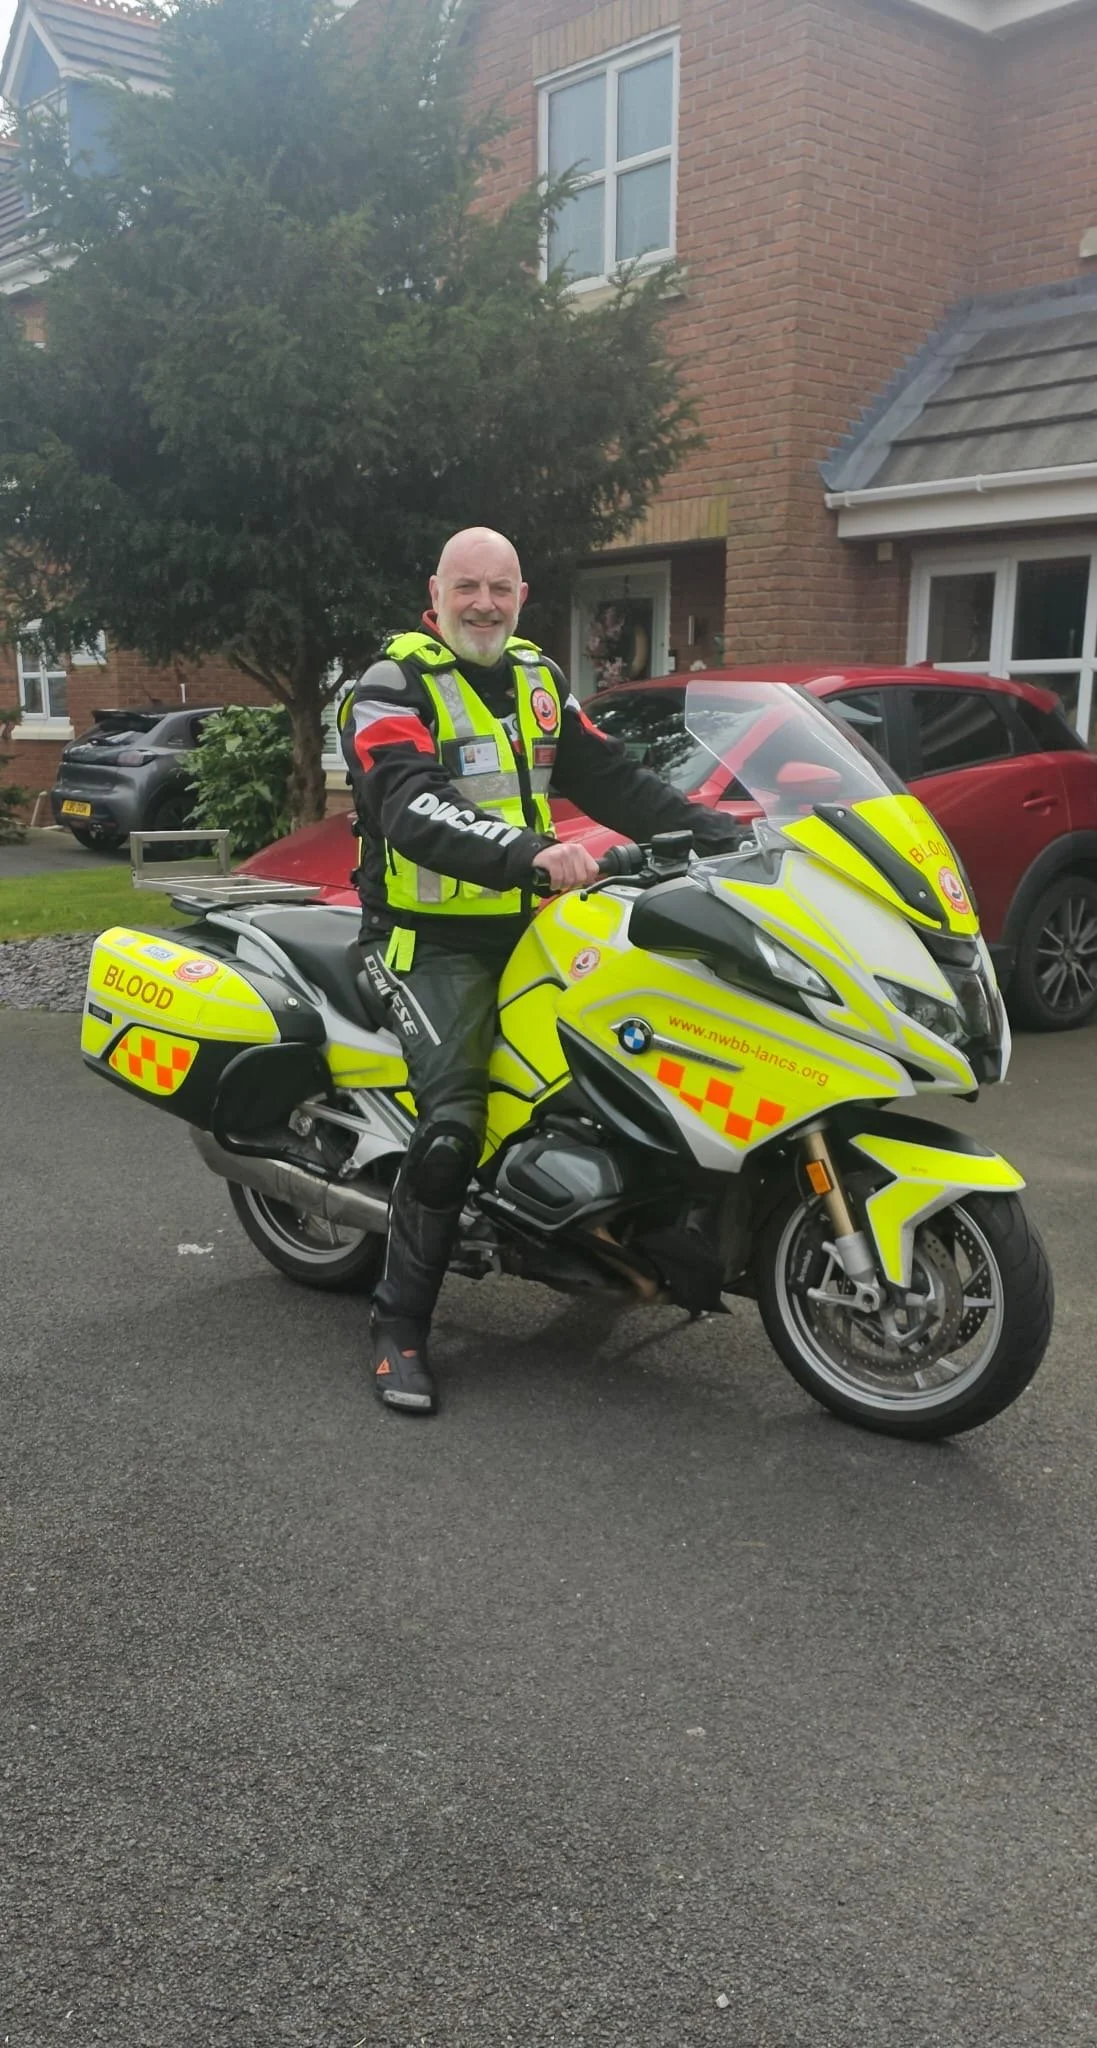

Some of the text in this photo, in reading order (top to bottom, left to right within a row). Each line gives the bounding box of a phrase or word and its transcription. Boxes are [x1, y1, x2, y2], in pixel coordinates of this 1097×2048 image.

[408, 792, 522, 847] DUCATI
[103, 964, 174, 1010] BLOOD
[668, 1015, 829, 1087] www.nwbb-lancs.org
